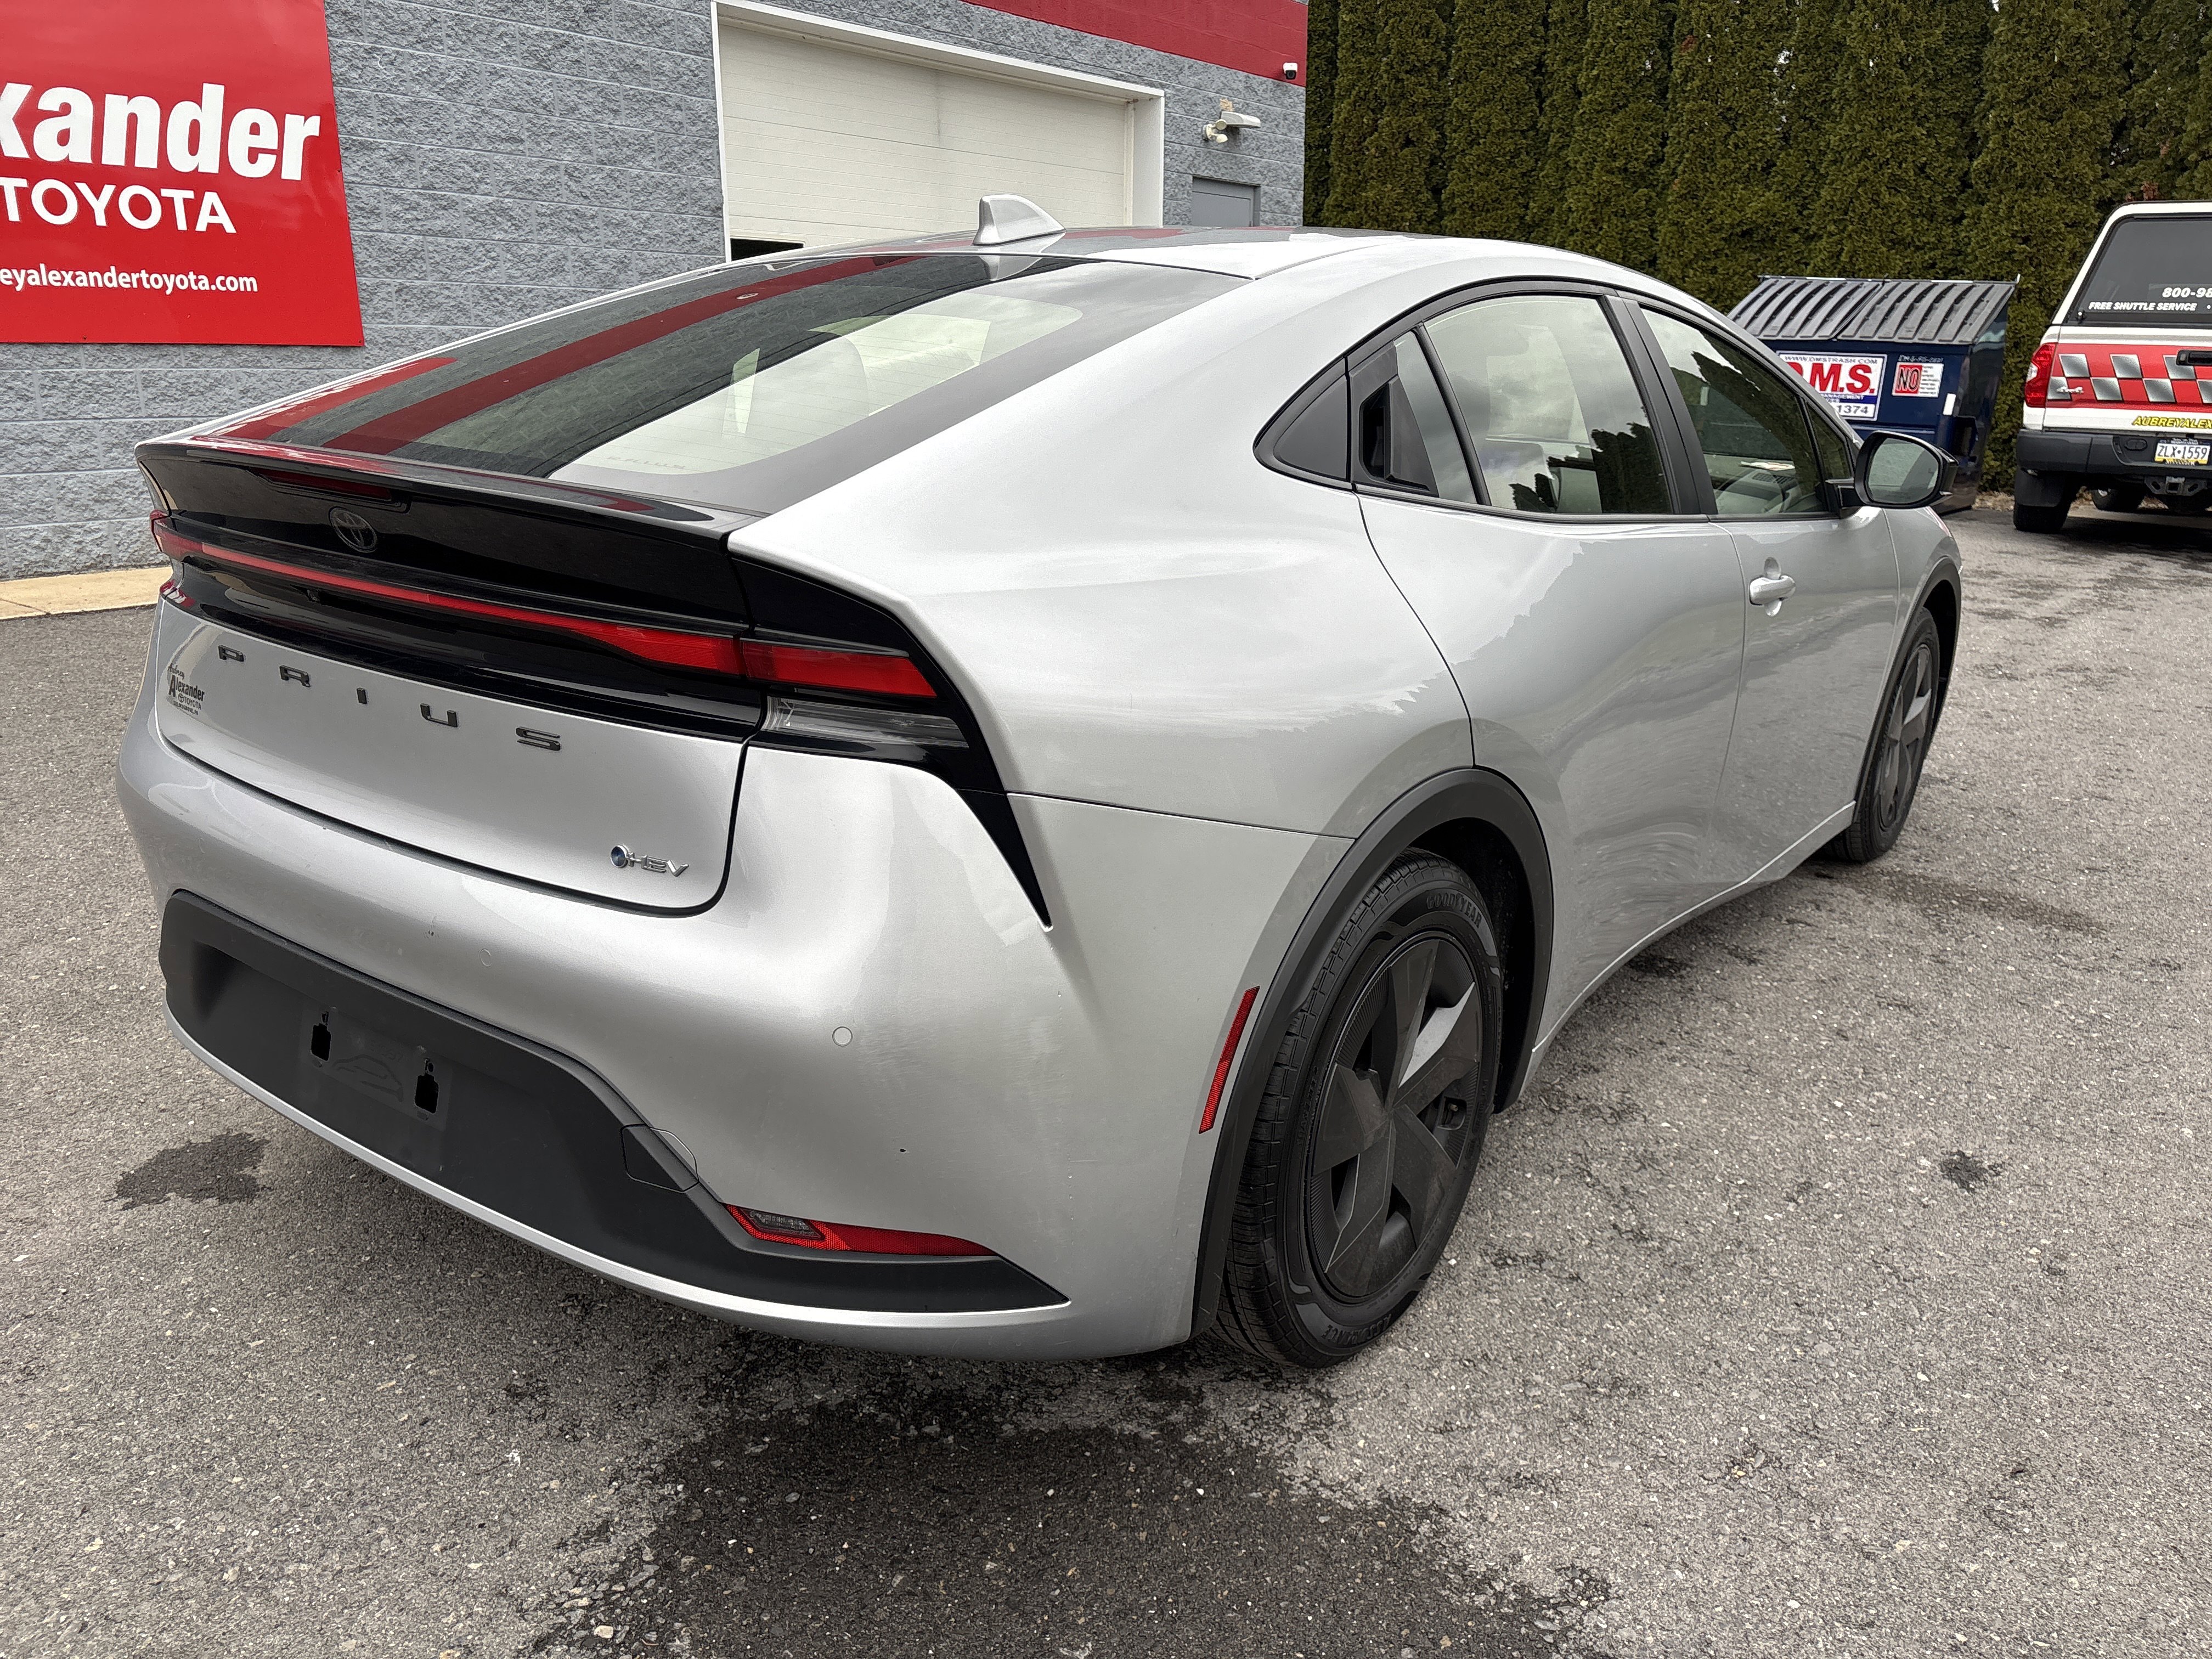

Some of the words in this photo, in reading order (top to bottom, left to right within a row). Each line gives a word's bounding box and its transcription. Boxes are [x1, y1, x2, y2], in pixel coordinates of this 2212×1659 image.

[0, 177, 236, 233] TOYOTA
[0, 263, 258, 295] eyalexandertoyota.com
[2089, 302, 2113, 310] FREE
[2113, 302, 2156, 311] SHUTTLE
[2157, 303, 2197, 311] SERVICE
[1896, 367, 1920, 392] NO
[169, 674, 205, 701] Alexander
[218, 645, 561, 751] PRIUS
[184, 696, 202, 710] TOYOTA
[1426, 893, 1481, 928] GOODYEAR
